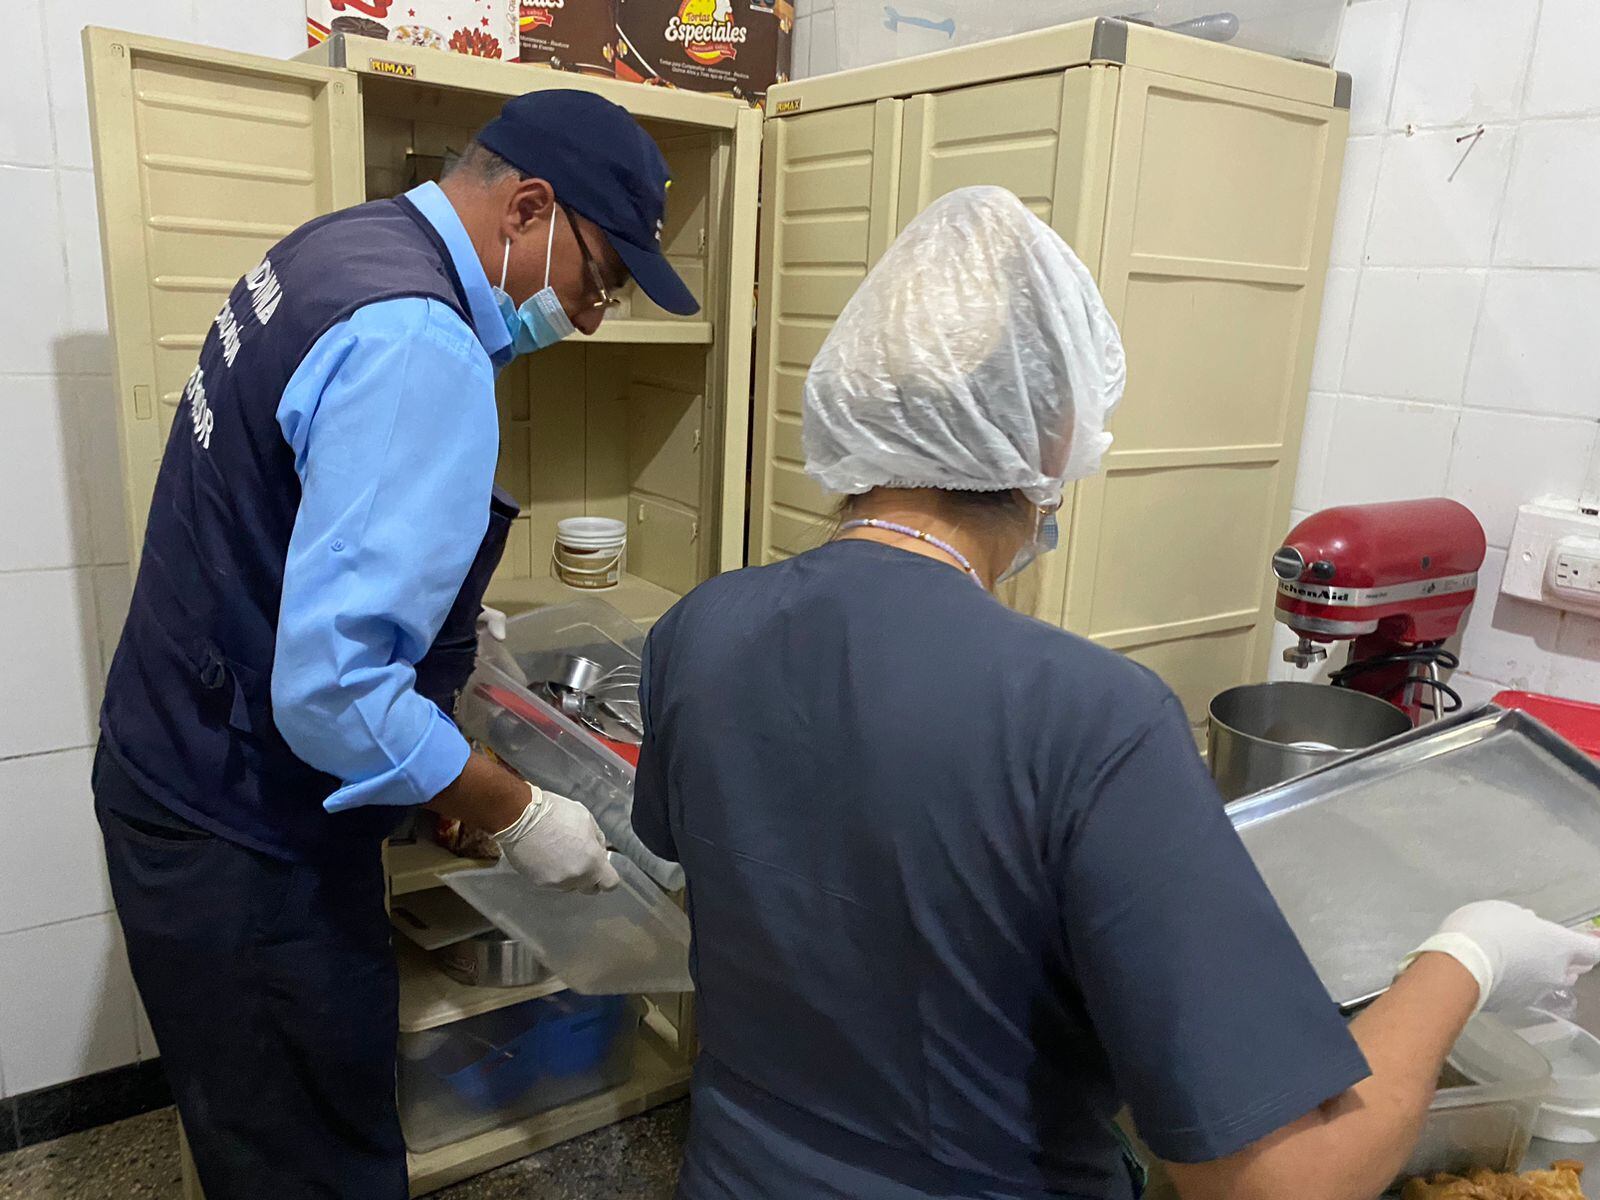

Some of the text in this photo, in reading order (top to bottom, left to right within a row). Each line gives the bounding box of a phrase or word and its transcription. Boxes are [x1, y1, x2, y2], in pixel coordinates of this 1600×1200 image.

[686, 12, 710, 22] Tortas
[664, 16, 747, 48] Especiales
[371, 60, 413, 77] RIMAX
